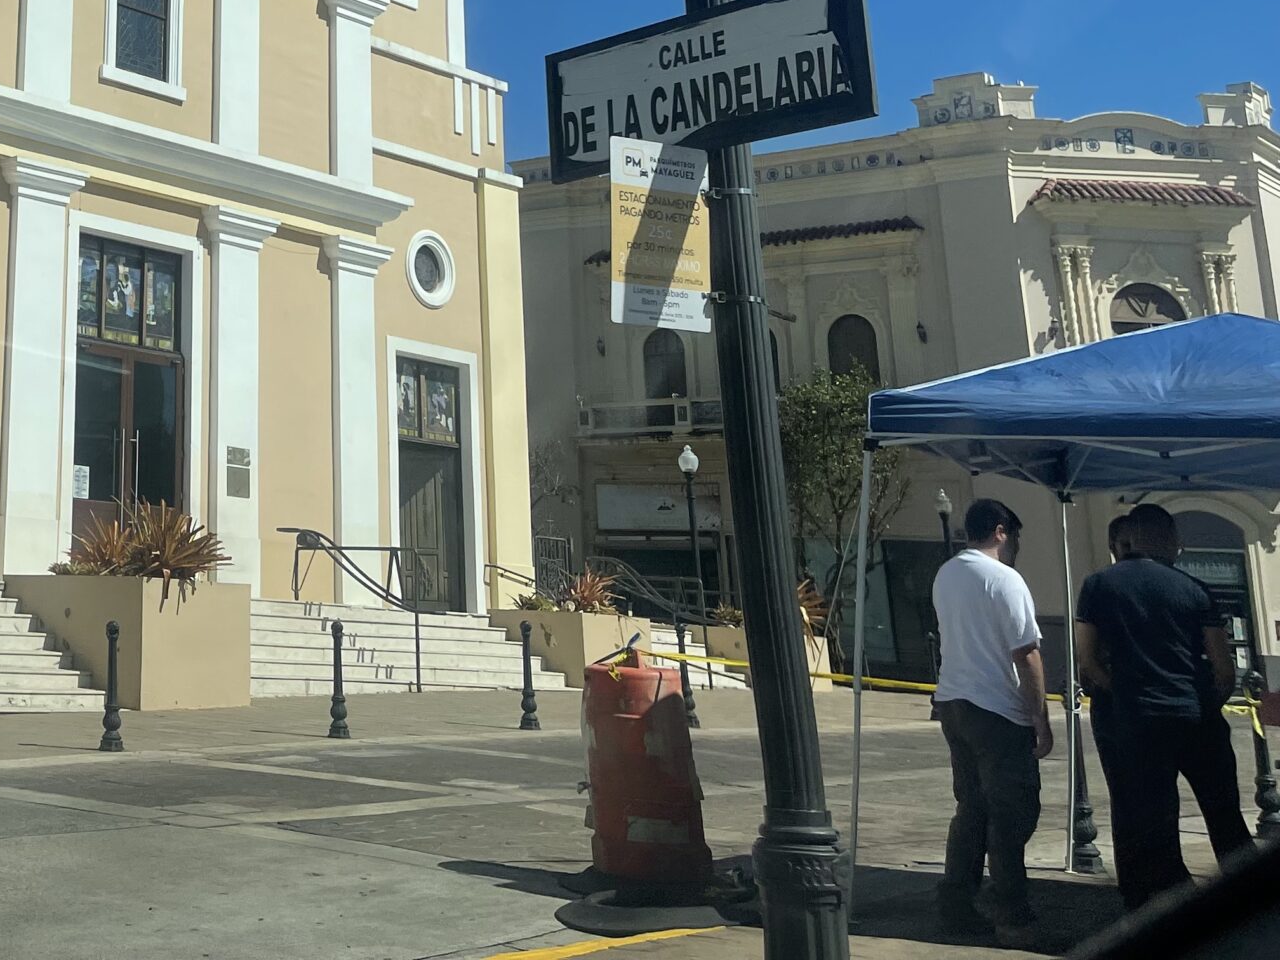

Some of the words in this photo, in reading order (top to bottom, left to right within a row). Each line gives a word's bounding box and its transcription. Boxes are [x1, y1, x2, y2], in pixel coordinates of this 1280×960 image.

[658, 30, 727, 70] CALLE
[563, 106, 597, 157] DE
[607, 94, 643, 139] LA
[651, 43, 850, 135] CANDELARIA
[625, 156, 642, 168] PM
[619, 191, 700, 211] ESTACIONAMIENTO
[620, 206, 663, 221] PAGANDO
[666, 212, 700, 225] METROS
[627, 241, 642, 250] por
[644, 242, 655, 251] 30
